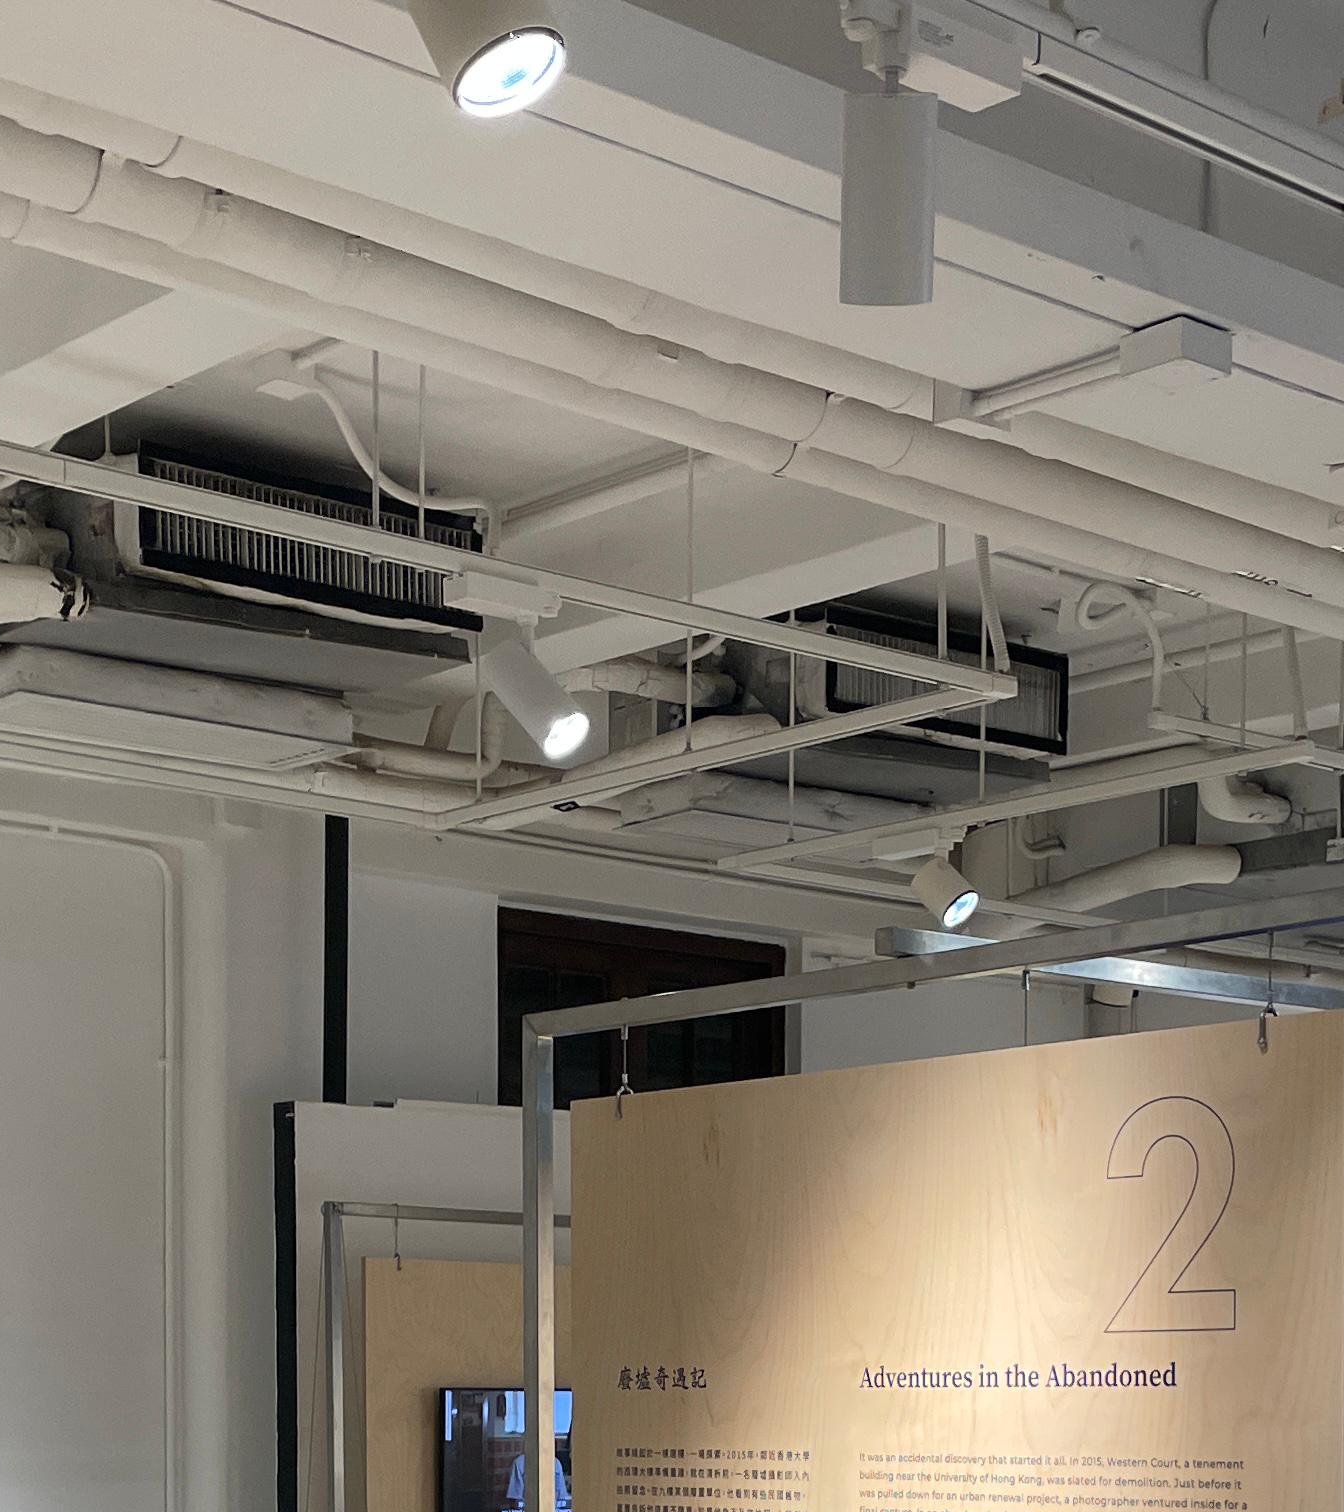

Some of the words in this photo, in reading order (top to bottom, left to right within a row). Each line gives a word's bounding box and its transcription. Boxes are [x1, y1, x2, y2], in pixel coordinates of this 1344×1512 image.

[1104, 1095, 1236, 1334] 2
[617, 1365, 707, 1391] 廢墟奇遇記
[859, 1365, 972, 1389] Adventures
[979, 1364, 999, 1387] in
[1005, 1364, 1039, 1387] the
[1045, 1362, 1177, 1387] Abandoned
[859, 1452, 865, 1462] It
[867, 1454, 883, 1463] was
[885, 1454, 896, 1463] an
[898, 1452, 942, 1464] accidental
[944, 1453, 986, 1467] discovery
[988, 1454, 1007, 1465] that
[1009, 1454, 1042, 1466] started
[1044, 1455, 1051, 1466] it
[1053, 1455, 1066, 1466] all.
[1069, 1455, 1078, 1466] In
[1081, 1456, 1104, 1470] 2015,
[1106, 1456, 1148, 1467] Western
[1150, 1457, 1181, 1471] Court,
[1183, 1460, 1189, 1468] a
[1192, 1458, 1243, 1469] tenement
[859, 1471, 893, 1485] building
[895, 1474, 915, 1483] near
[916, 1472, 931, 1483] the
[933, 1472, 977, 1487] University
[979, 1473, 988, 1484] of
[990, 1474, 1015, 1488] Hong
[1017, 1474, 1044, 1488] Kong,
[1046, 1477, 1065, 1486] was
[1067, 1475, 1096, 1487] slated
[1098, 1476, 1111, 1487] for
[1114, 1477, 1170, 1488] demolition.
[1173, 1478, 1194, 1489] Just
[1197, 1478, 1231, 1490] before
[1234, 1479, 1241, 1490] it
[859, 1490, 875, 1499] was
[877, 1489, 904, 1503] pulled
[905, 1489, 929, 1501] down
[931, 1490, 944, 1501] for
[946, 1493, 957, 1501] an
[959, 1491, 985, 1502] urban
[988, 1492, 1024, 1503] renewal
[1026, 1493, 1061, 1507] project,
[1064, 1496, 1069, 1504] a
[1072, 1494, 1139, 1509] photographer
[1141, 1496, 1188, 1508] ventured
[1190, 1498, 1221, 1509] inside
[1224, 1499, 1238, 1510] for
[1241, 1502, 1247, 1510] a
